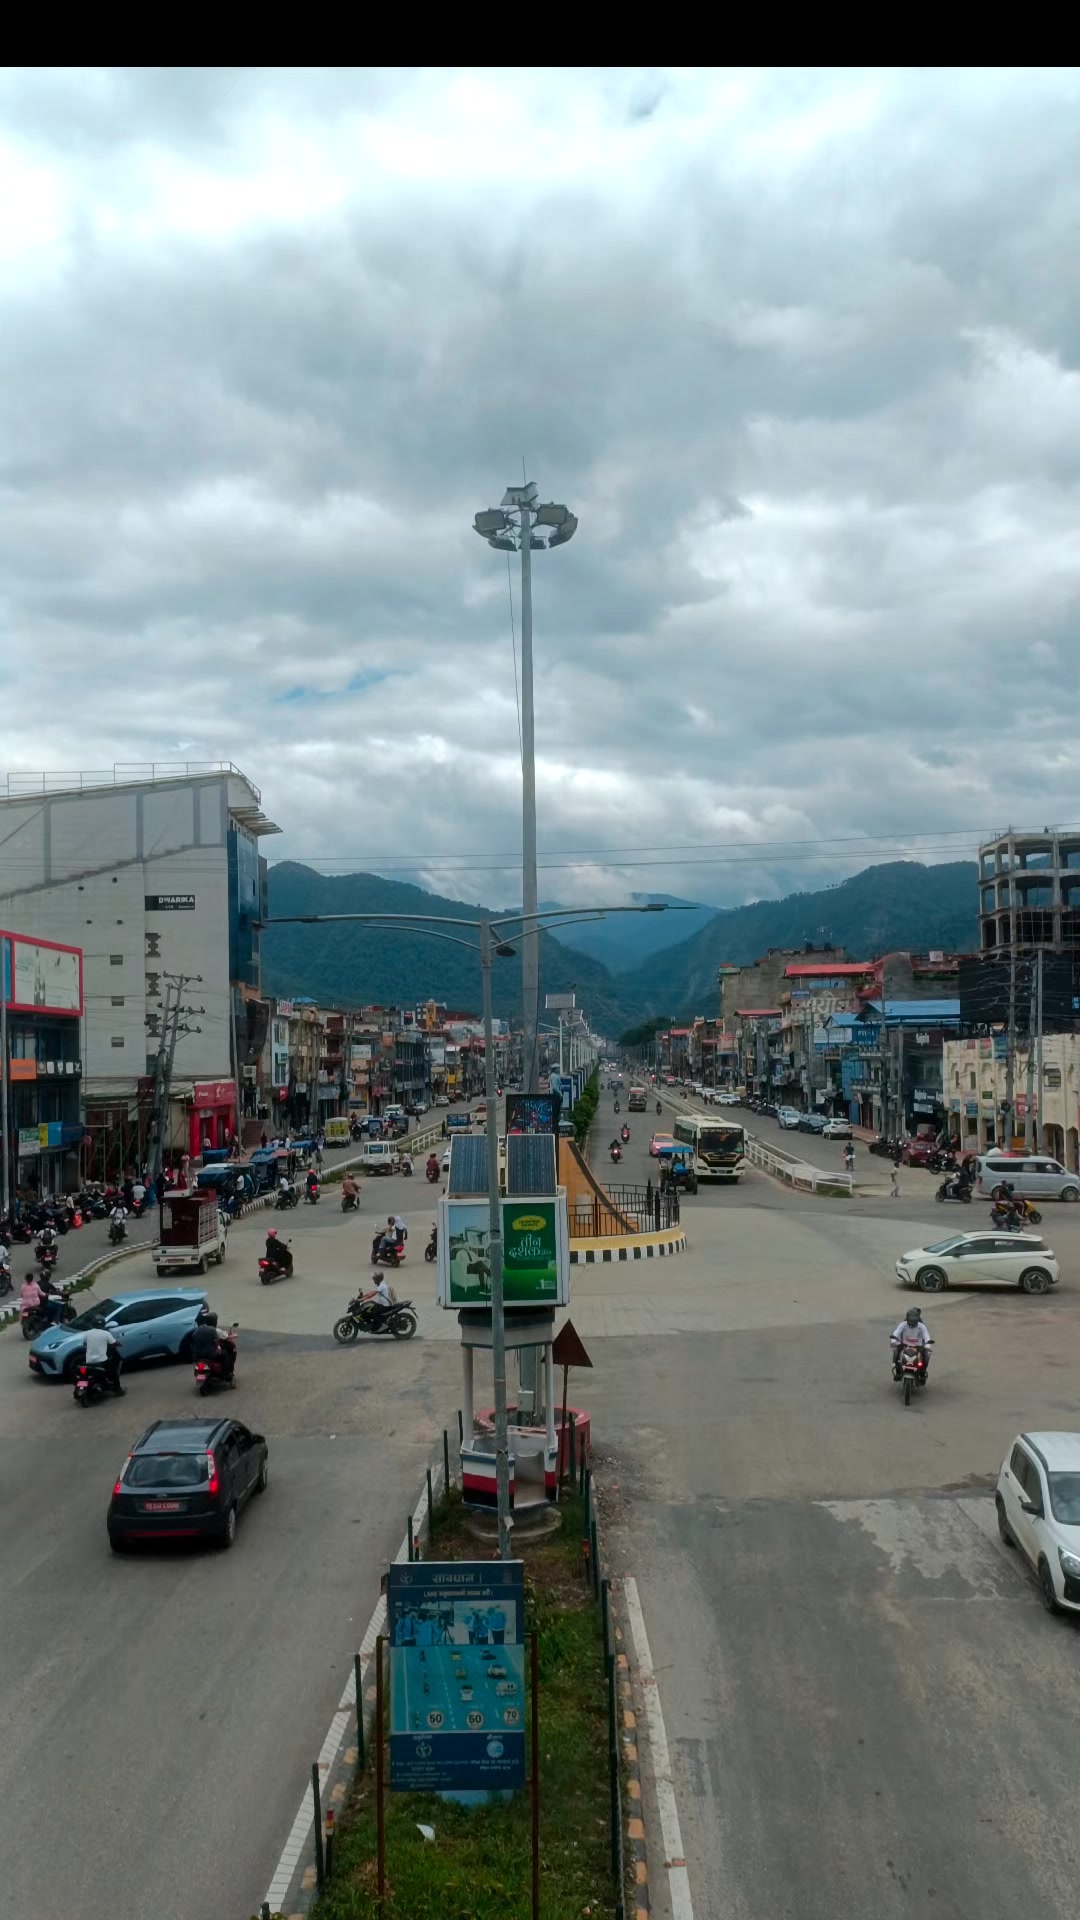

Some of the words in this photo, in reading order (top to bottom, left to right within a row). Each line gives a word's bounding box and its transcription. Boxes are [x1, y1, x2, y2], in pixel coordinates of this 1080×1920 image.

[158, 896, 195, 904] DWARIKA
[520, 1234, 541, 1248] तीन
[508, 1247, 541, 1259] दशक
[429, 1713, 443, 1723] 50
[507, 1711, 517, 1720] 70
